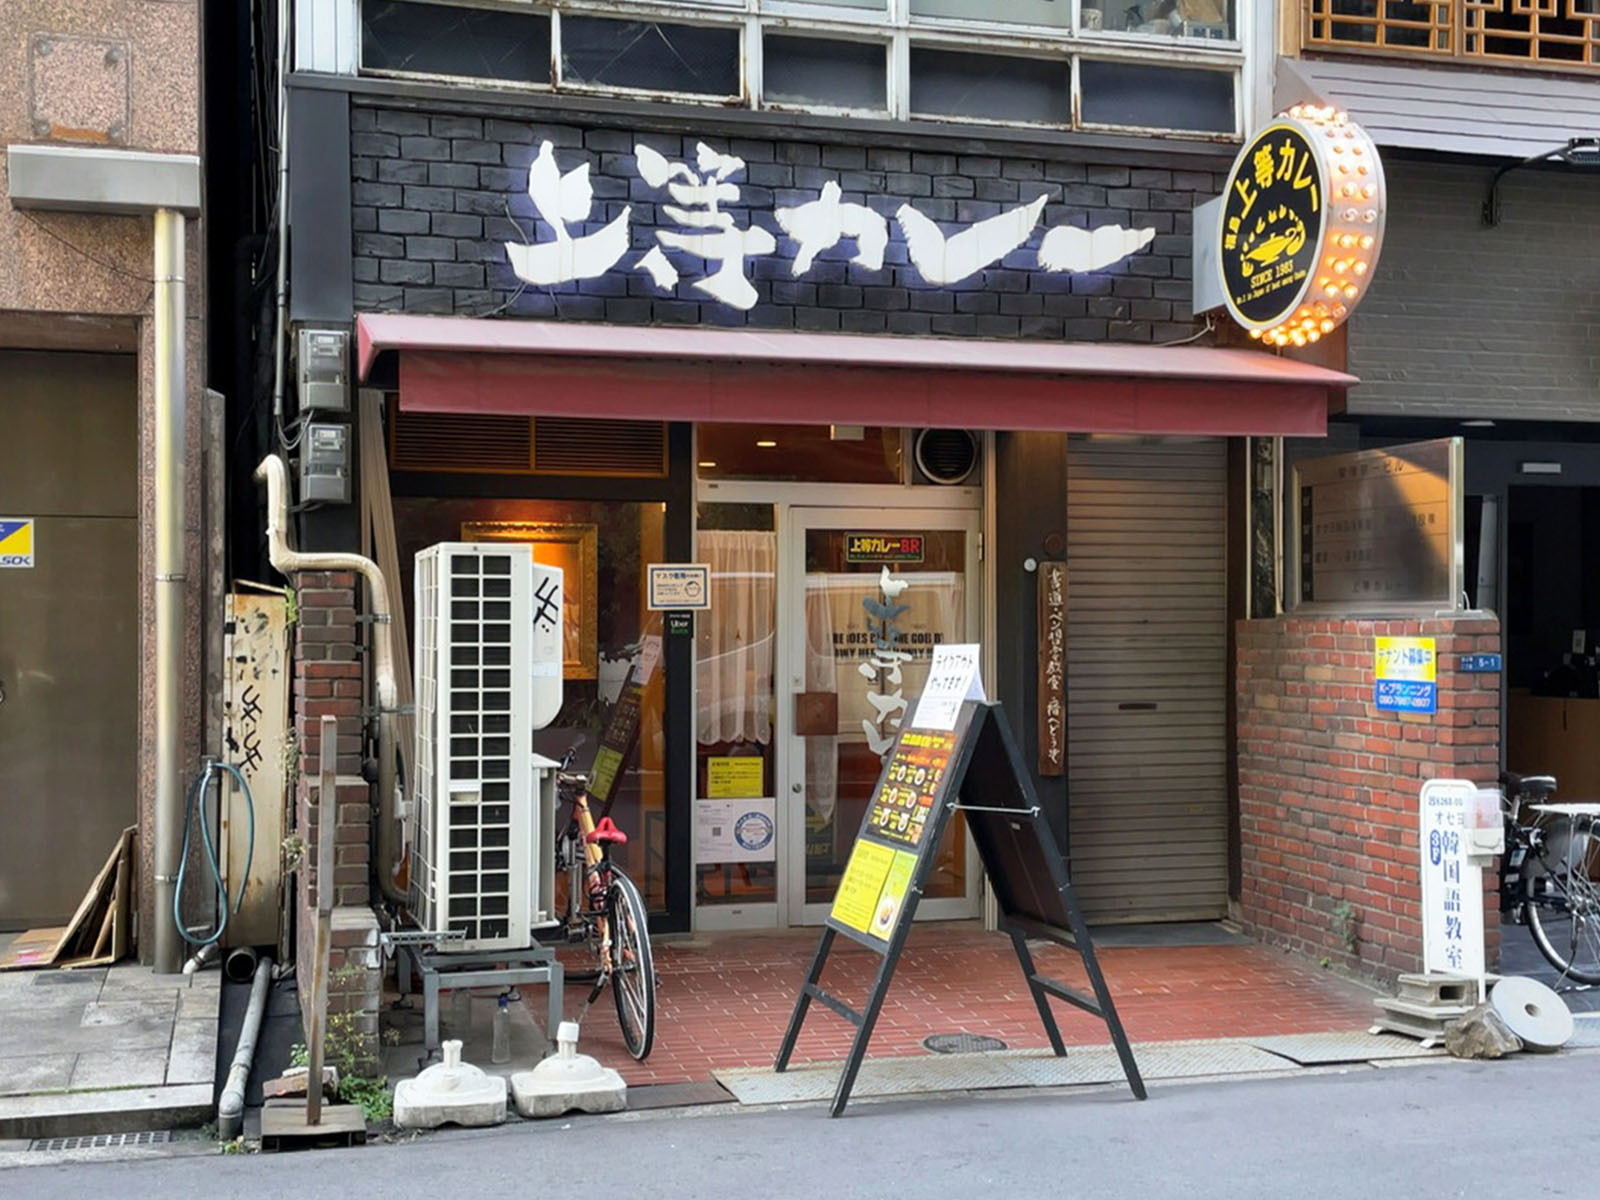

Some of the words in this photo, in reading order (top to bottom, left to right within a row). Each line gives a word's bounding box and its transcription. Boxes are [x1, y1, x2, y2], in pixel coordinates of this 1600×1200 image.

[504, 139, 1156, 311] 上等カレー
[1251, 268, 1273, 289] SINCE
[670, 619, 689, 628] Uber
[1442, 829, 1463, 970] 韓国語教室
